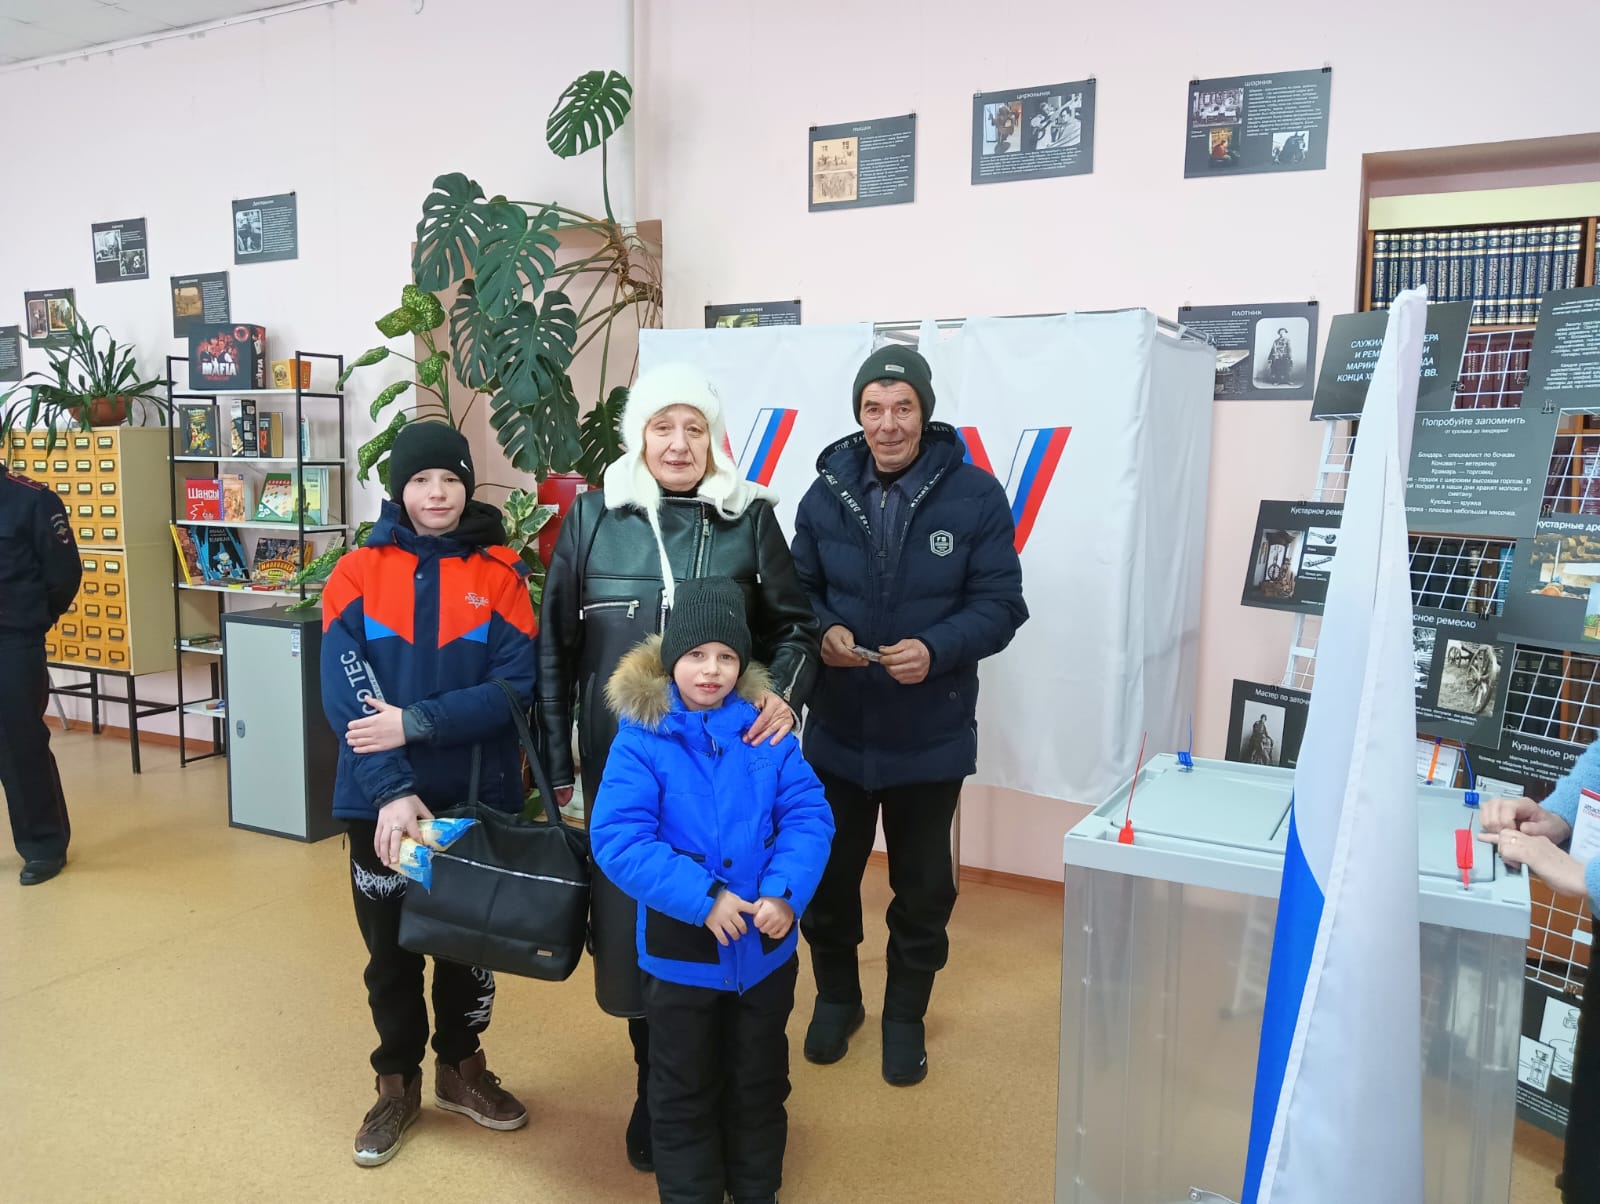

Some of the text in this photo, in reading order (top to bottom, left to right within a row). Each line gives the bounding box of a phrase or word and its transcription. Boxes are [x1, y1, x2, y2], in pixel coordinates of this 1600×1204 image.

[1351, 333, 1440, 349] СЛУЖИЛ ЕРА
[1362, 349, 1381, 359] РЕМ
[1421, 356, 1435, 367] ДА
[202, 360, 237, 377] MAFIA
[1336, 372, 1365, 383] КОНЦА
[1421, 416, 1526, 428] Попробуйте запомнить
[1418, 451, 1443, 459] Бондарь
[1444, 477, 1472, 485] широким
[187, 487, 220, 501] Шансы
[1290, 507, 1325, 517] Кустарное
[1585, 523, 1600, 533] дре
[1413, 613, 1478, 629] сное ремесло
[340, 650, 366, 688] TEC
[1255, 688, 1311, 706] Мастер по заточ
[1511, 739, 1579, 763] Кузнечное рем
